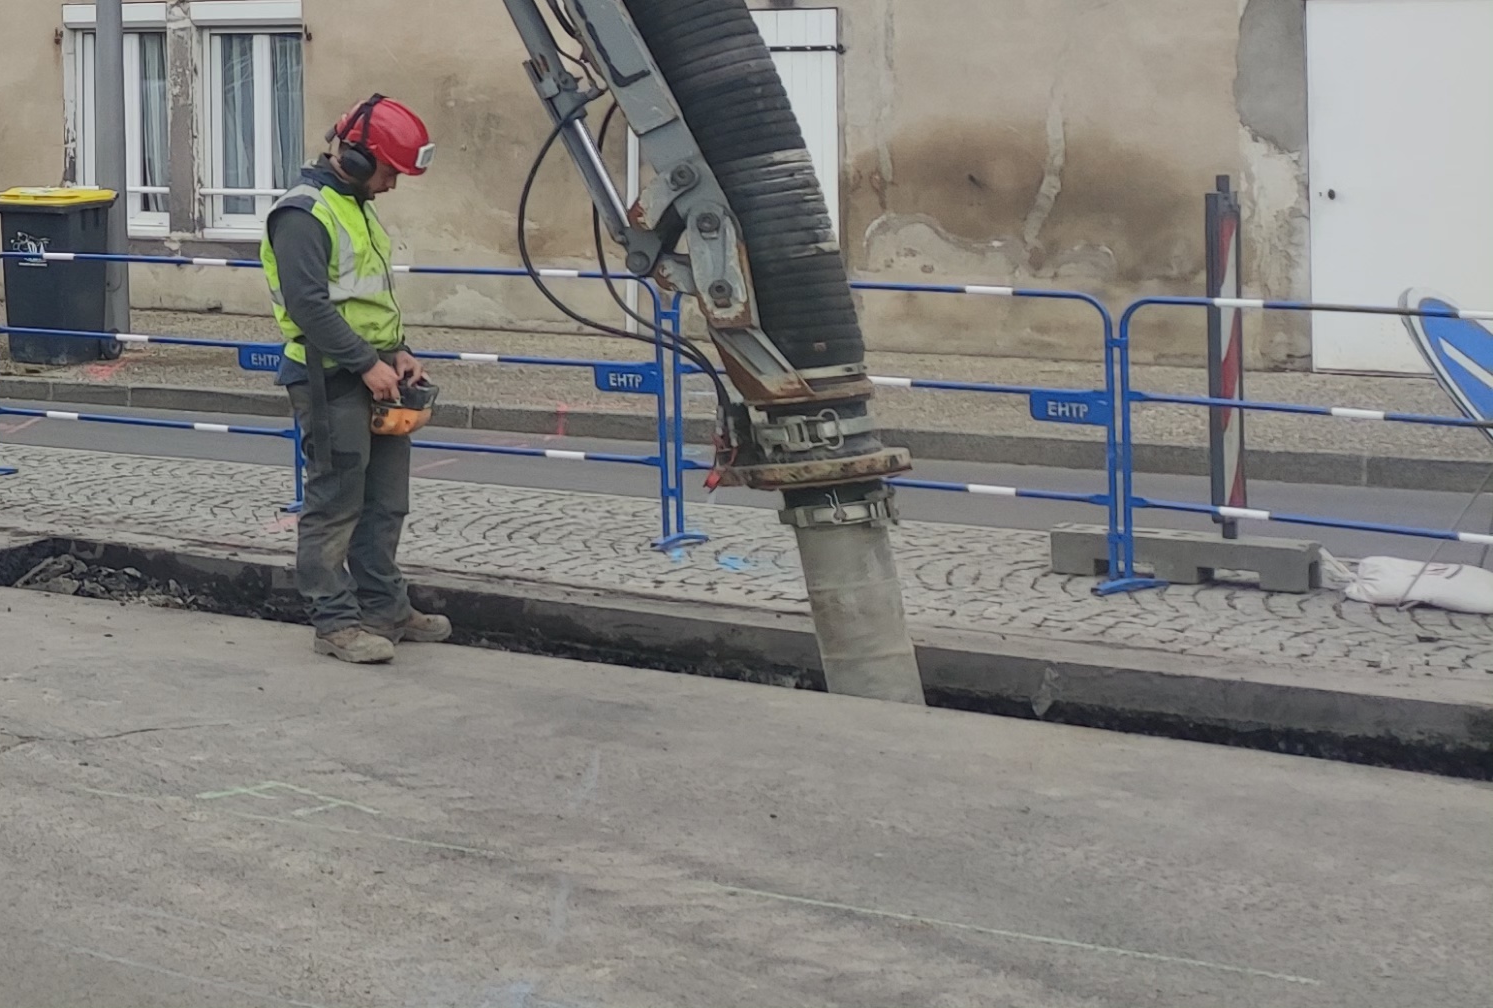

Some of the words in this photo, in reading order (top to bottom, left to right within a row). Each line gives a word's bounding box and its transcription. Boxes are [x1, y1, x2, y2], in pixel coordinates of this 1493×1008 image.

[251, 353, 280, 367] EHTP
[609, 373, 643, 388] EHTP
[1047, 400, 1089, 419] EHTP
